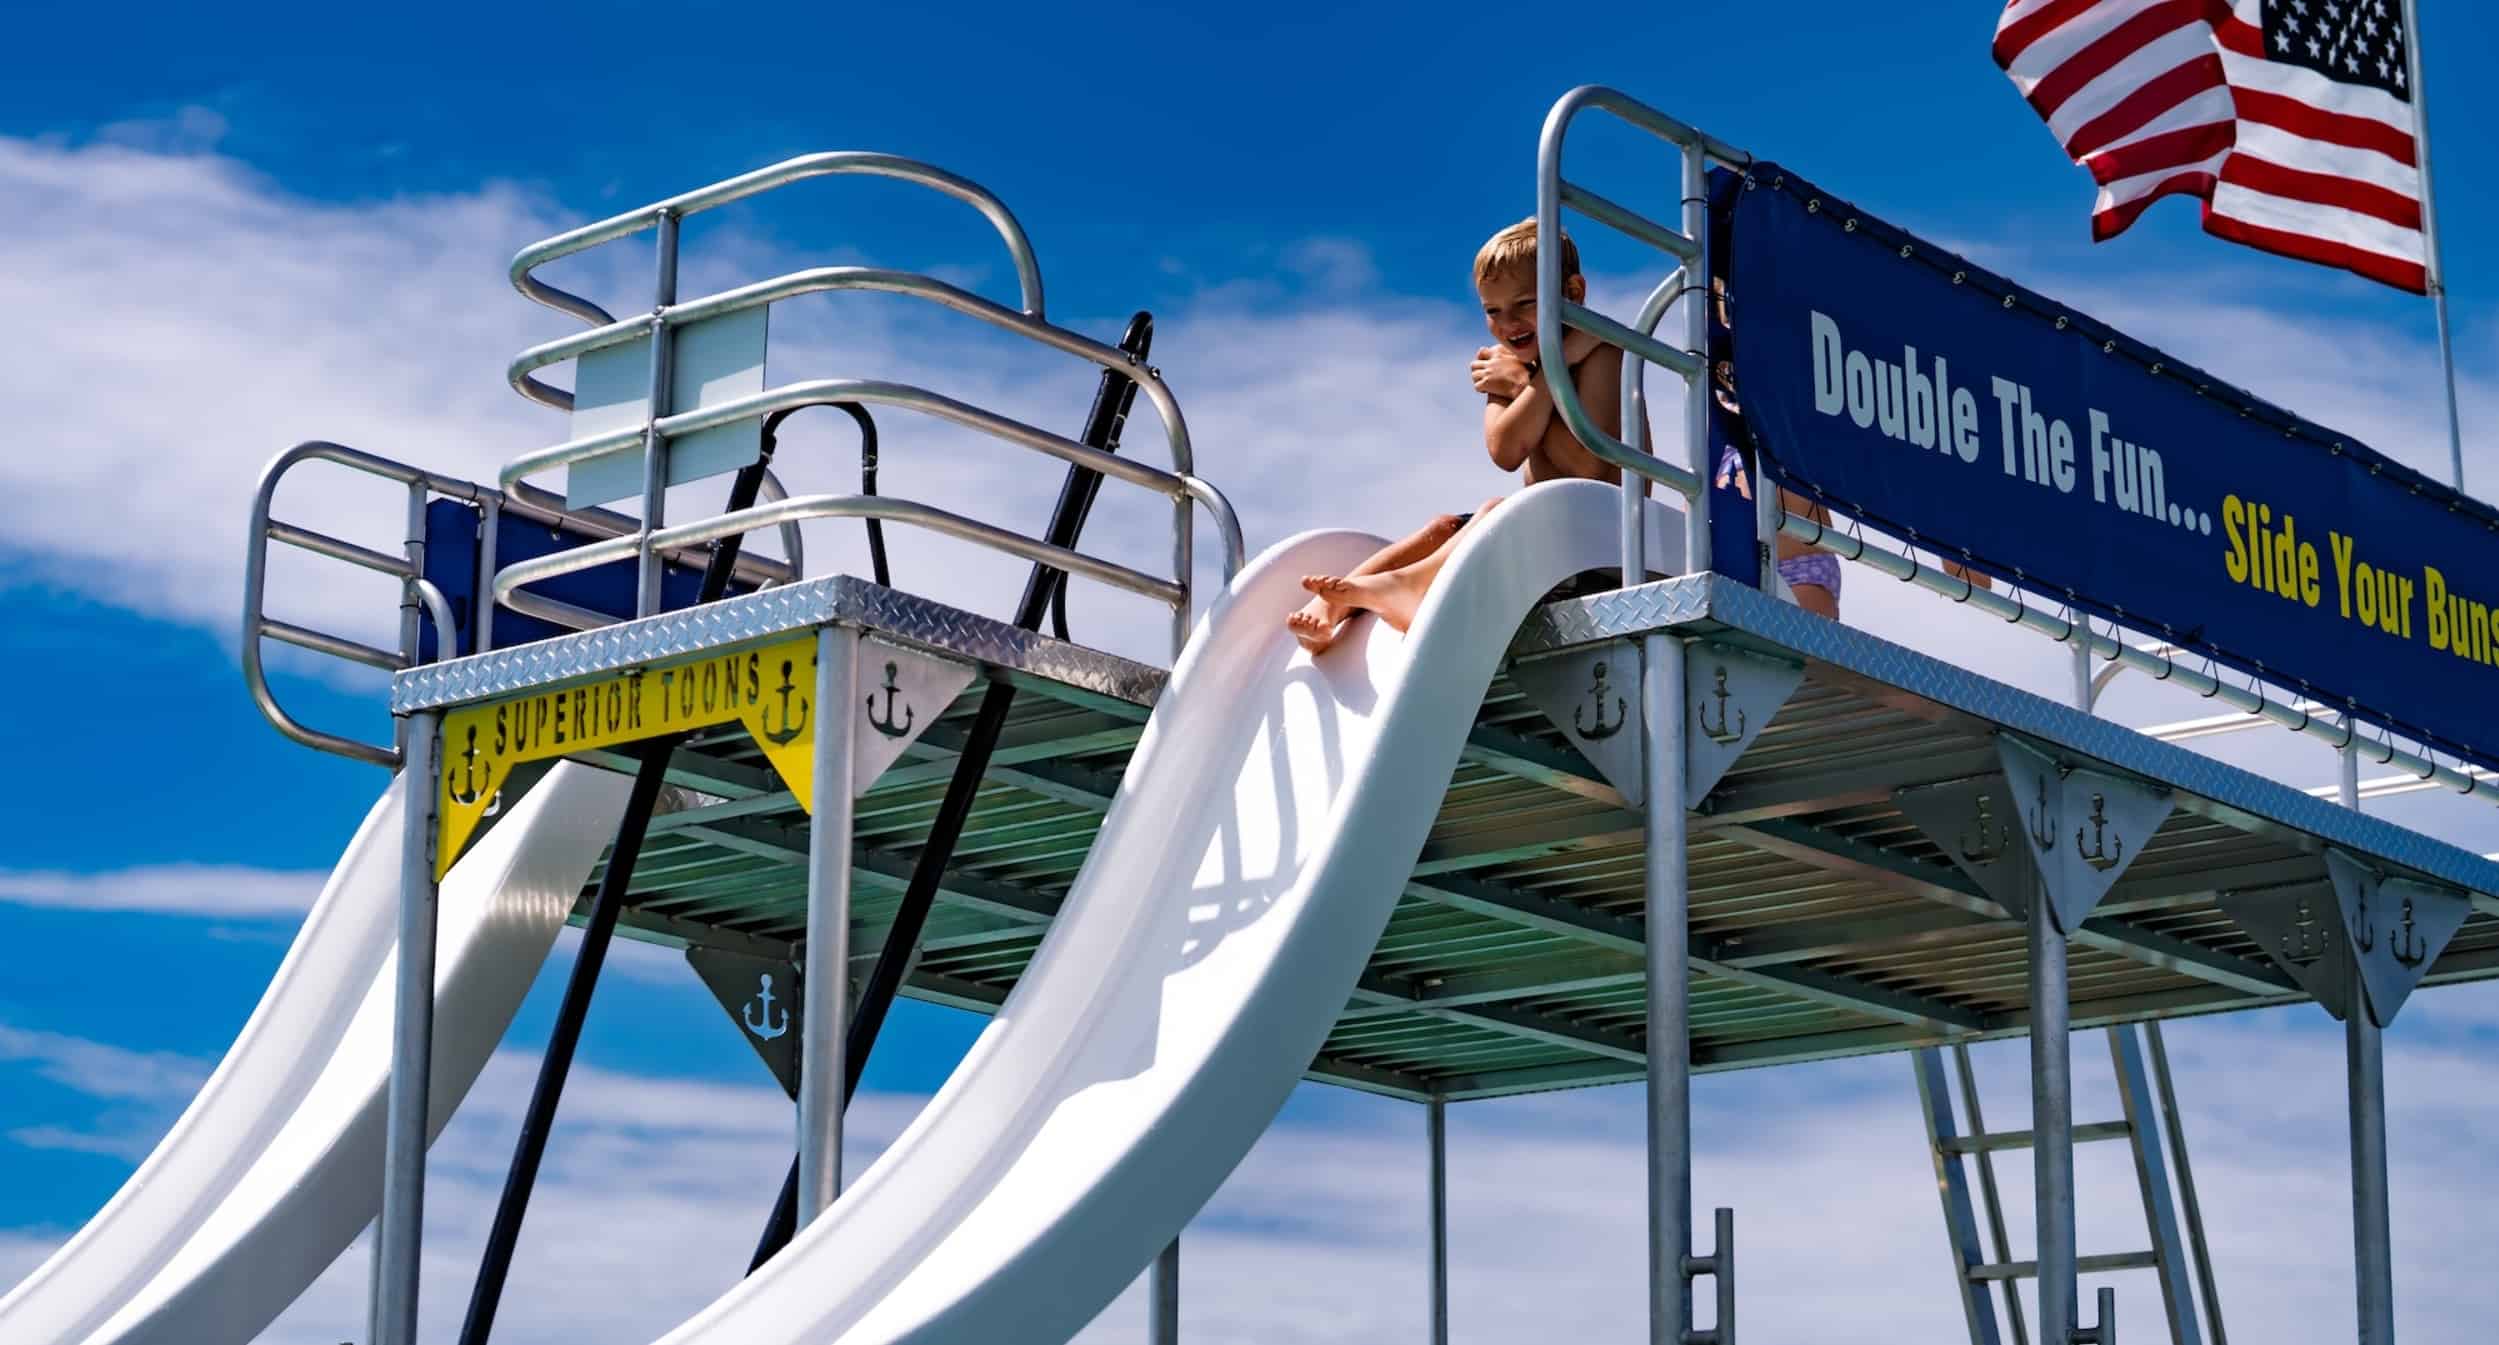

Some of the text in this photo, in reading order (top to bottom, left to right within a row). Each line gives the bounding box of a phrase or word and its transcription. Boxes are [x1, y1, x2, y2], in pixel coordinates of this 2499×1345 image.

[1810, 310, 1979, 463] Double
[1991, 375, 2075, 493] The
[2088, 407, 2211, 535] Fun...
[2222, 494, 2321, 608] Slide
[2329, 531, 2414, 639] Your
[495, 652, 760, 756] SUPERIOR TOONS
